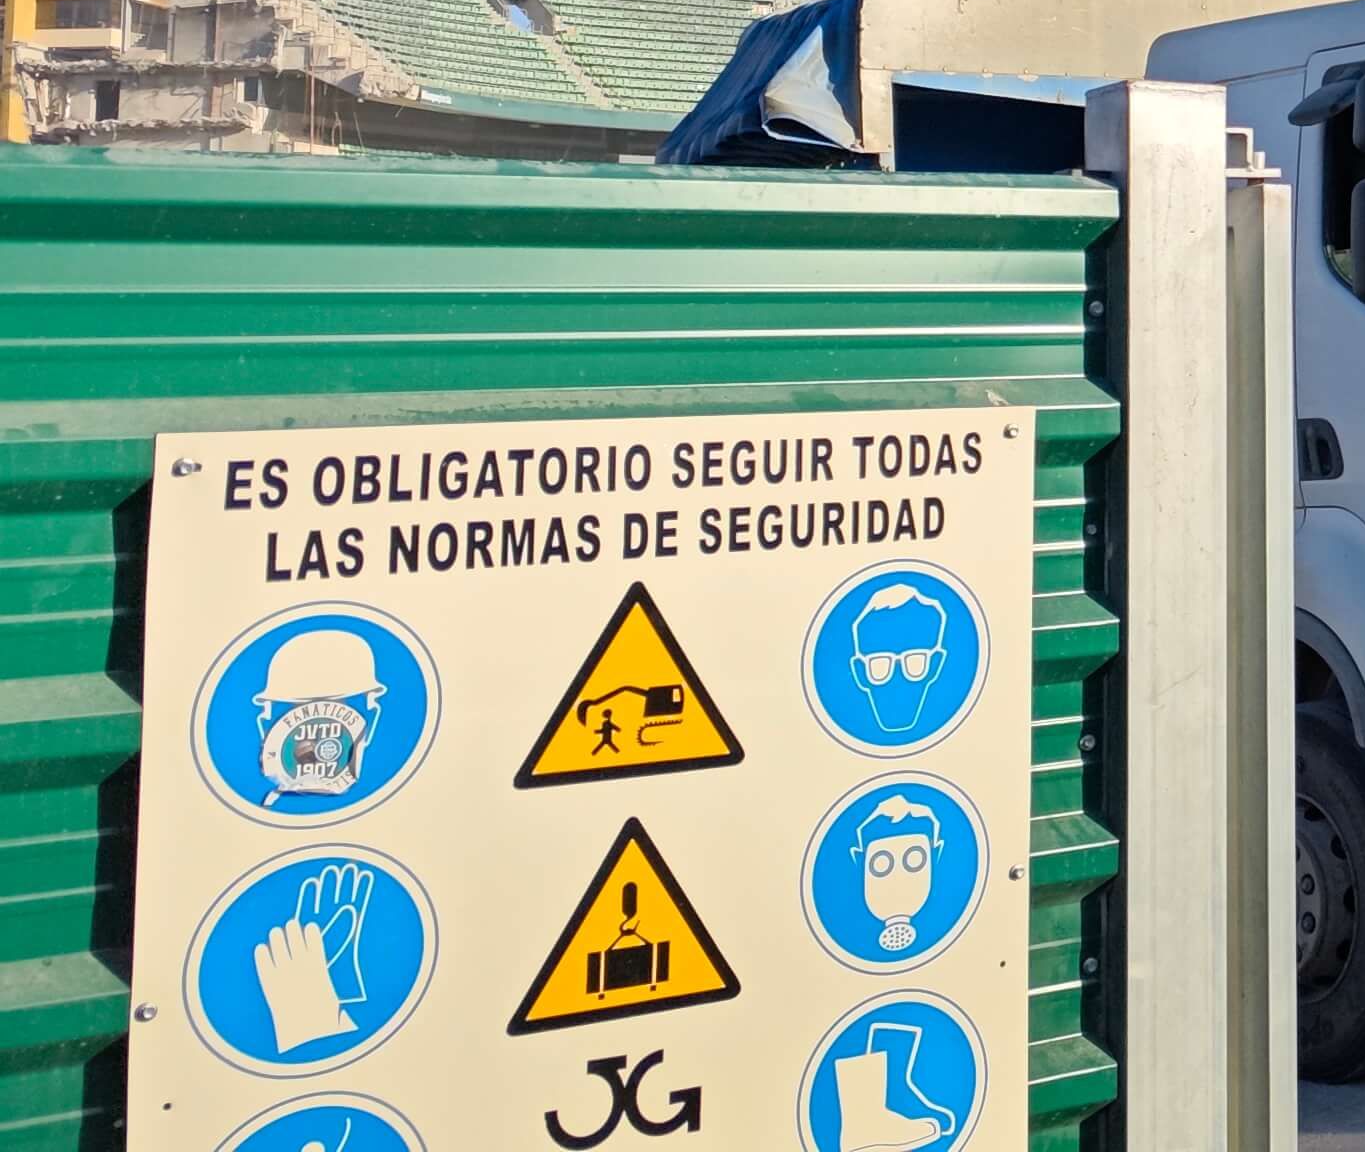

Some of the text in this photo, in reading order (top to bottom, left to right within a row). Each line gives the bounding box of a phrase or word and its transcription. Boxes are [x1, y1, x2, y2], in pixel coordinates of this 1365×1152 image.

[224, 432, 982, 510] ES OBLIGATORIO SEGUIR TODAS
[266, 497, 945, 582] LAS NORMAS DE SEGURIDAD
[296, 761, 338, 779] 1907
